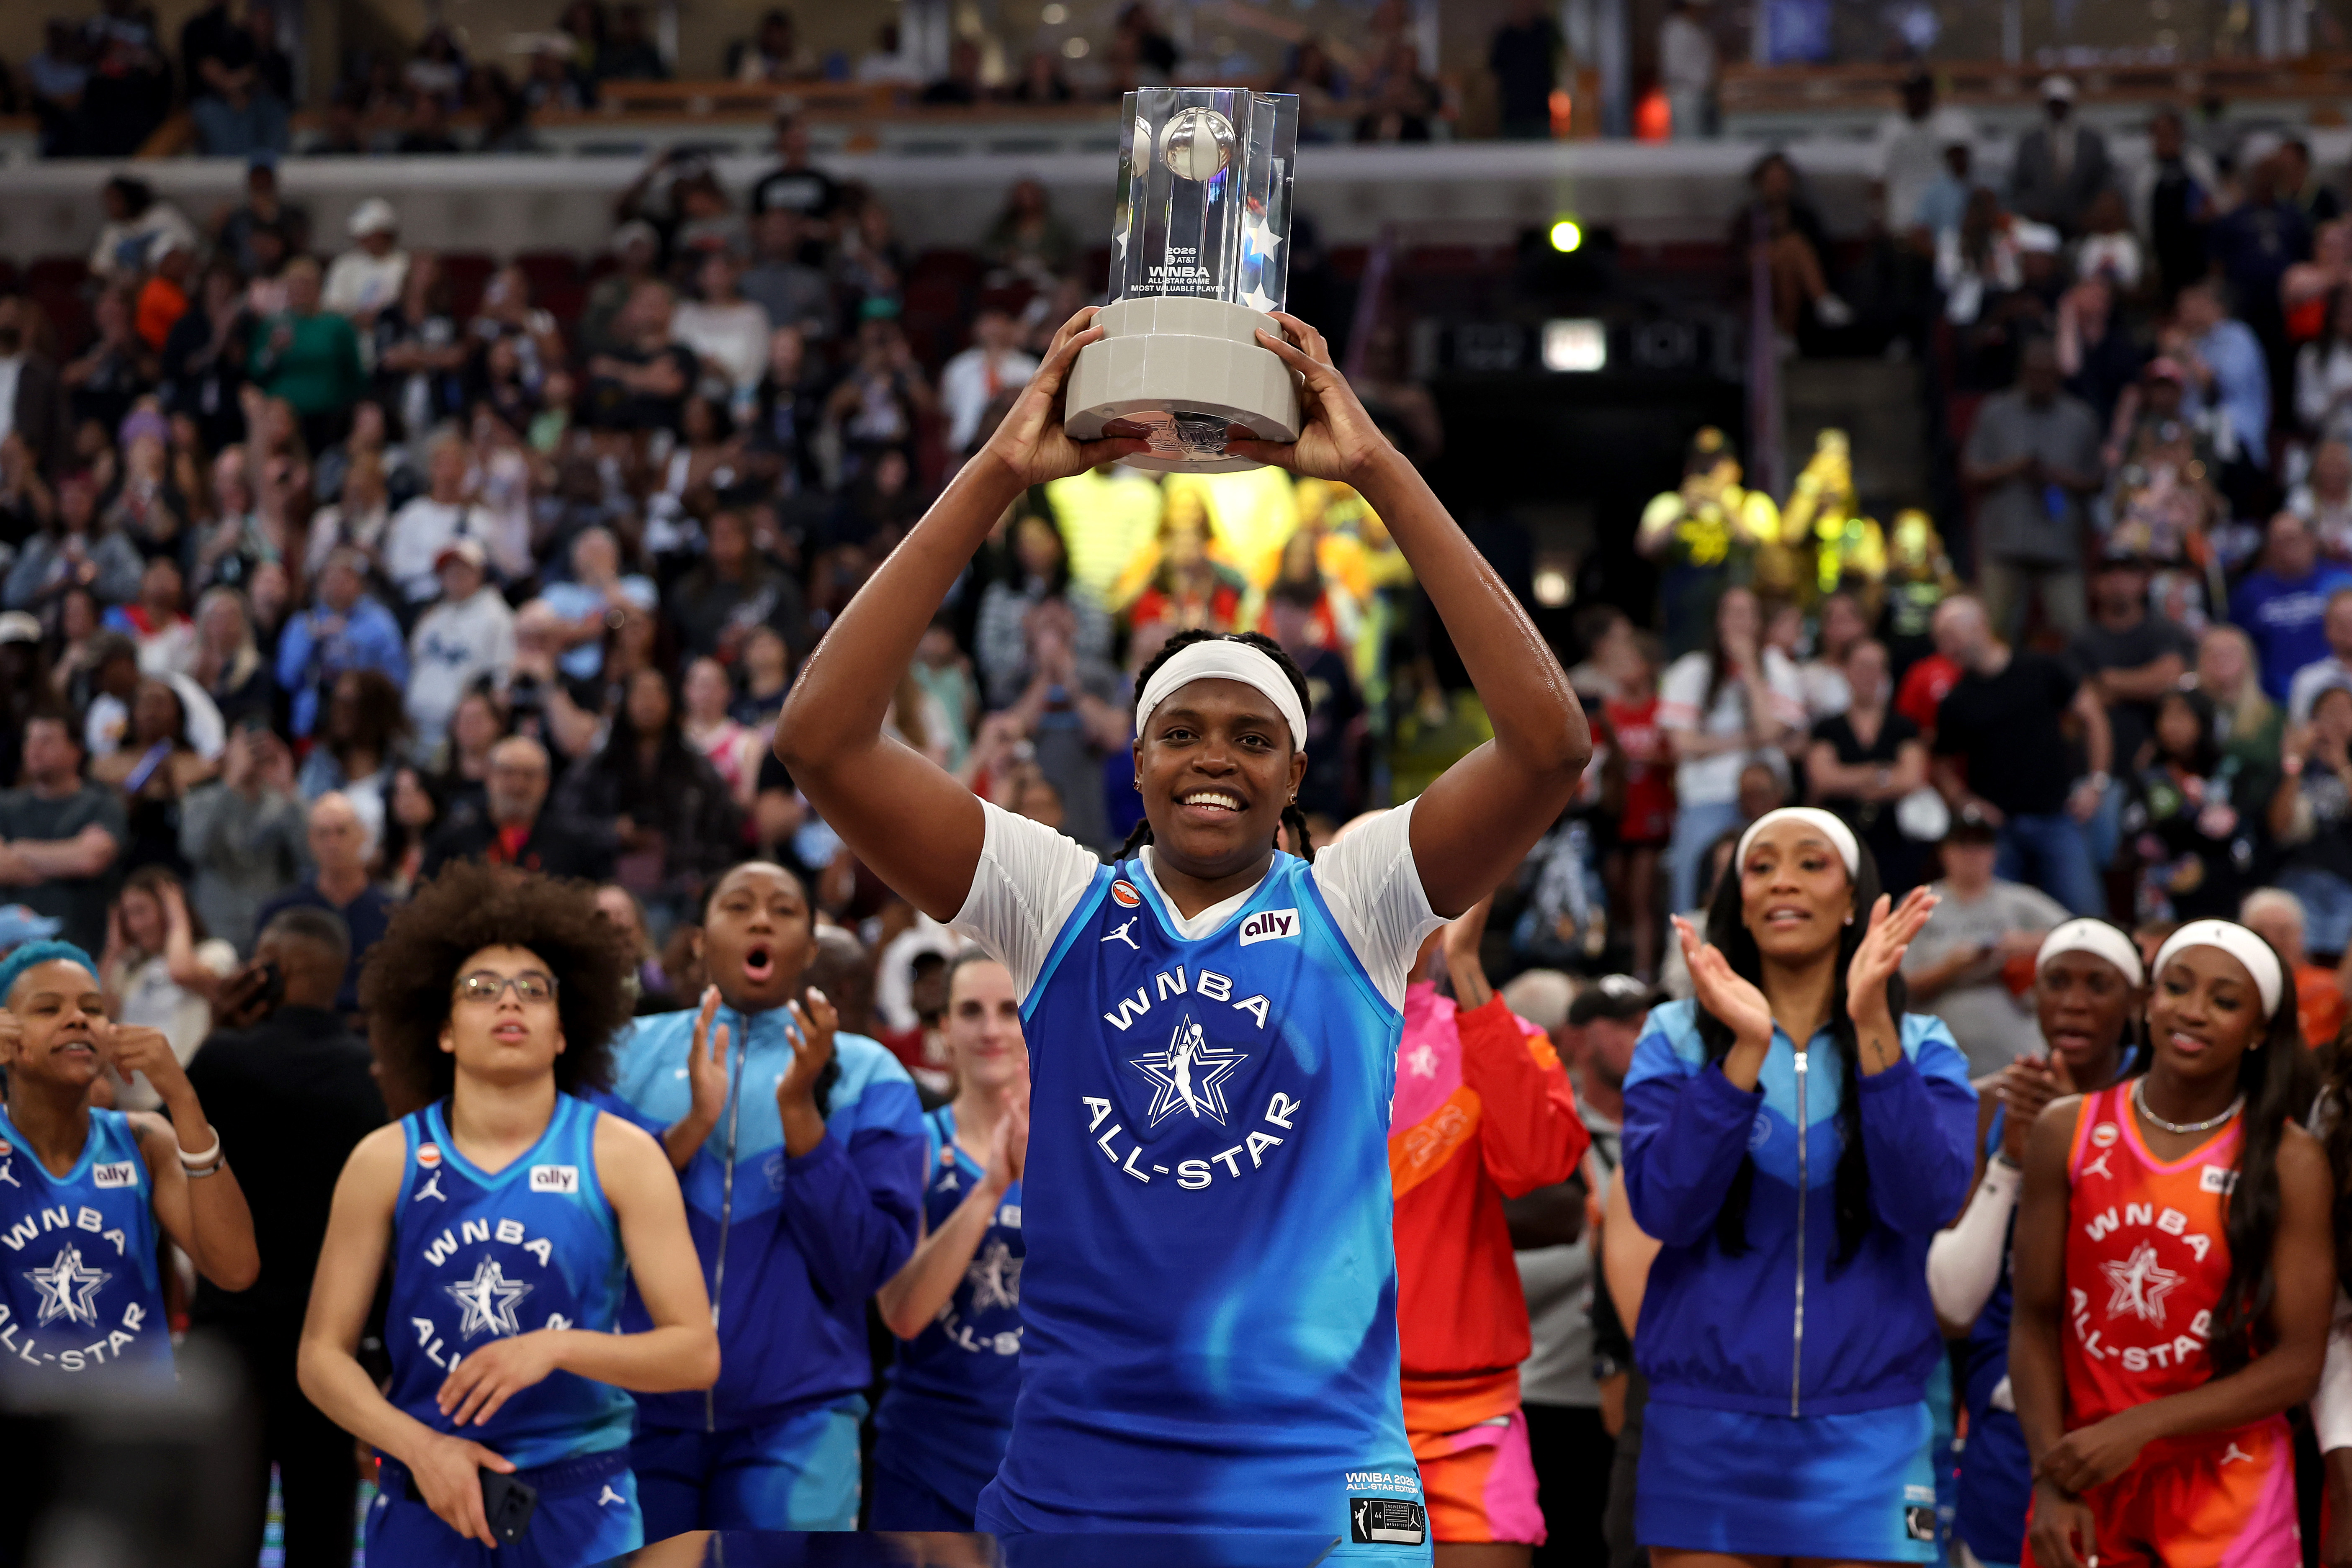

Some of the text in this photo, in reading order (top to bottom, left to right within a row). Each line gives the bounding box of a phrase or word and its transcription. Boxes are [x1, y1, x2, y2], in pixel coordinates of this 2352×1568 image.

[1149, 266, 1210, 277] WNBA
[1244, 913, 1292, 937] ally
[1104, 965, 1271, 1031] WNBA
[1082, 1092, 1301, 1190] ALL-STAR
[97, 1166, 130, 1183] ally
[537, 1170, 573, 1190] ally
[1, 1204, 125, 1256] WNBA
[423, 1216, 553, 1267] WNBA
[2084, 1202, 2211, 1262] WNBA
[1346, 1473, 1415, 1487] WNBA 2026
[1395, 1485, 1419, 1493] EDITION
